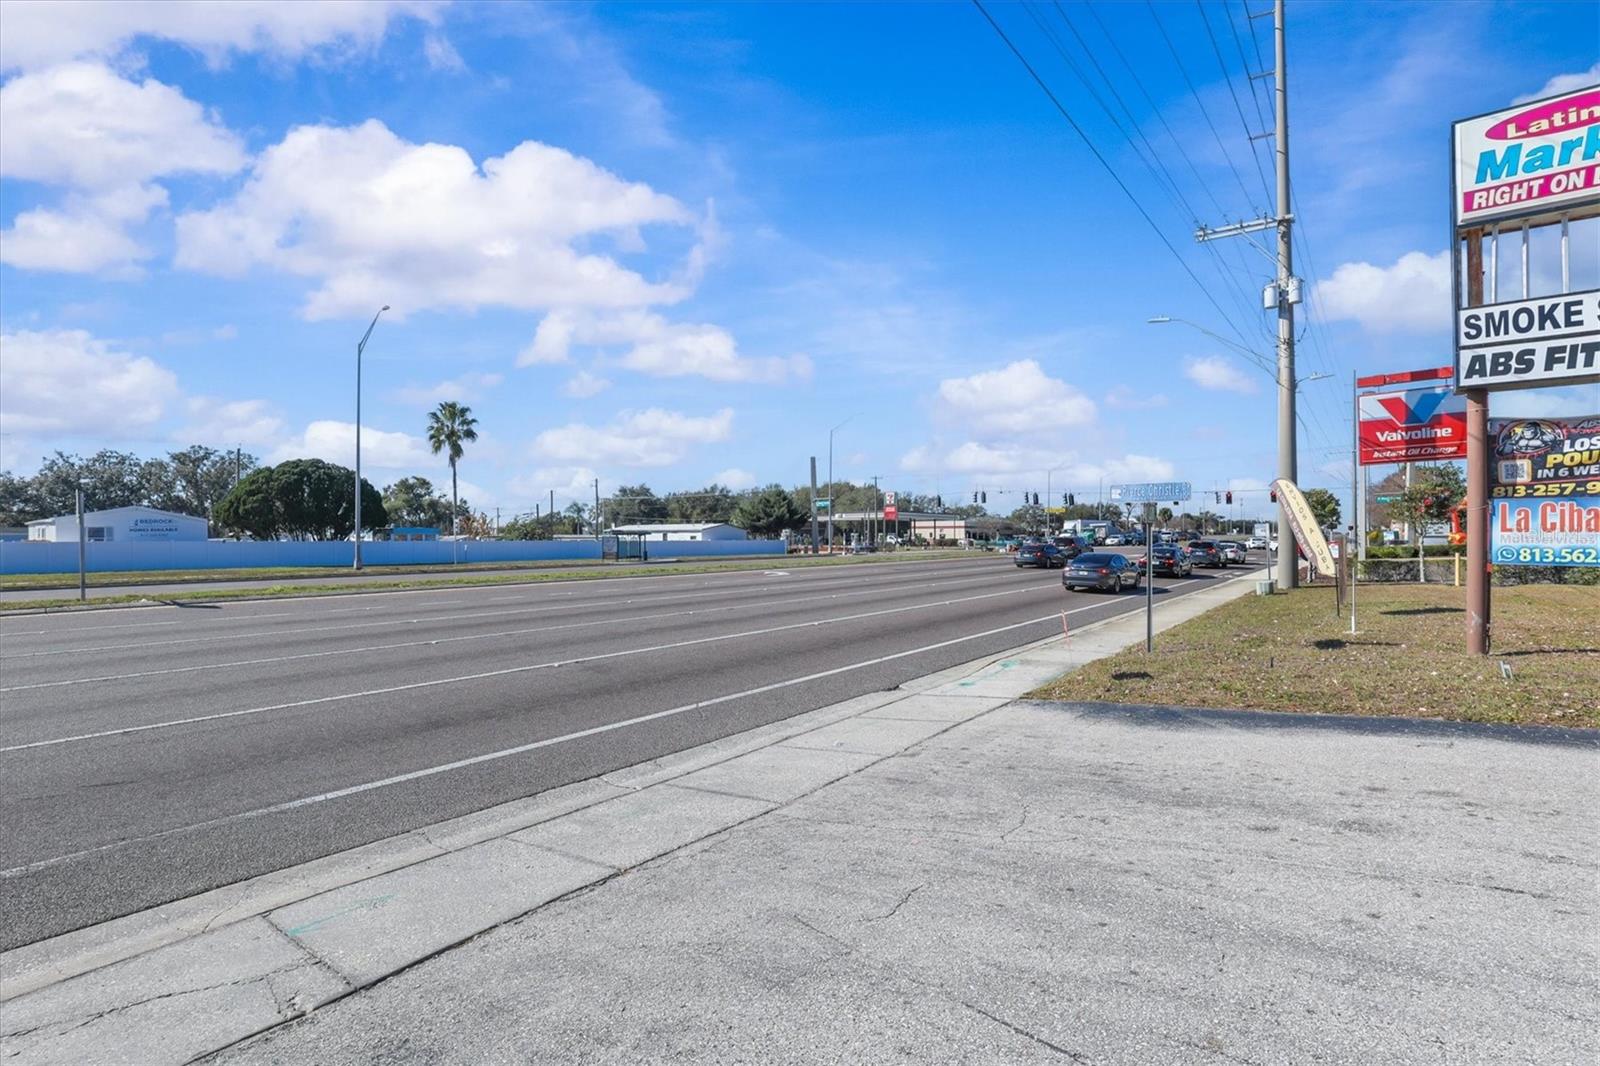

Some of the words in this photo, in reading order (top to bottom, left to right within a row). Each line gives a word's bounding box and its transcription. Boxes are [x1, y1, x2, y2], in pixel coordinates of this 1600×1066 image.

[1472, 178, 1544, 210] RIGHT
[1550, 169, 1586, 193] ON
[1464, 300, 1584, 340] SMOKE
[1464, 349, 1536, 379] ABS
[1544, 341, 1600, 372] FIT
[1376, 427, 1453, 442] Valvoline
[1563, 435, 1600, 452] LOS
[1373, 449, 1406, 458] Instant
[1421, 446, 1458, 455] Change
[1546, 450, 1600, 468] POU
[1537, 469, 1554, 478] IN
[1558, 467, 1569, 477] 6
[1573, 464, 1600, 475] WE
[1499, 502, 1532, 533] La
[1540, 502, 1600, 533] Ciba
